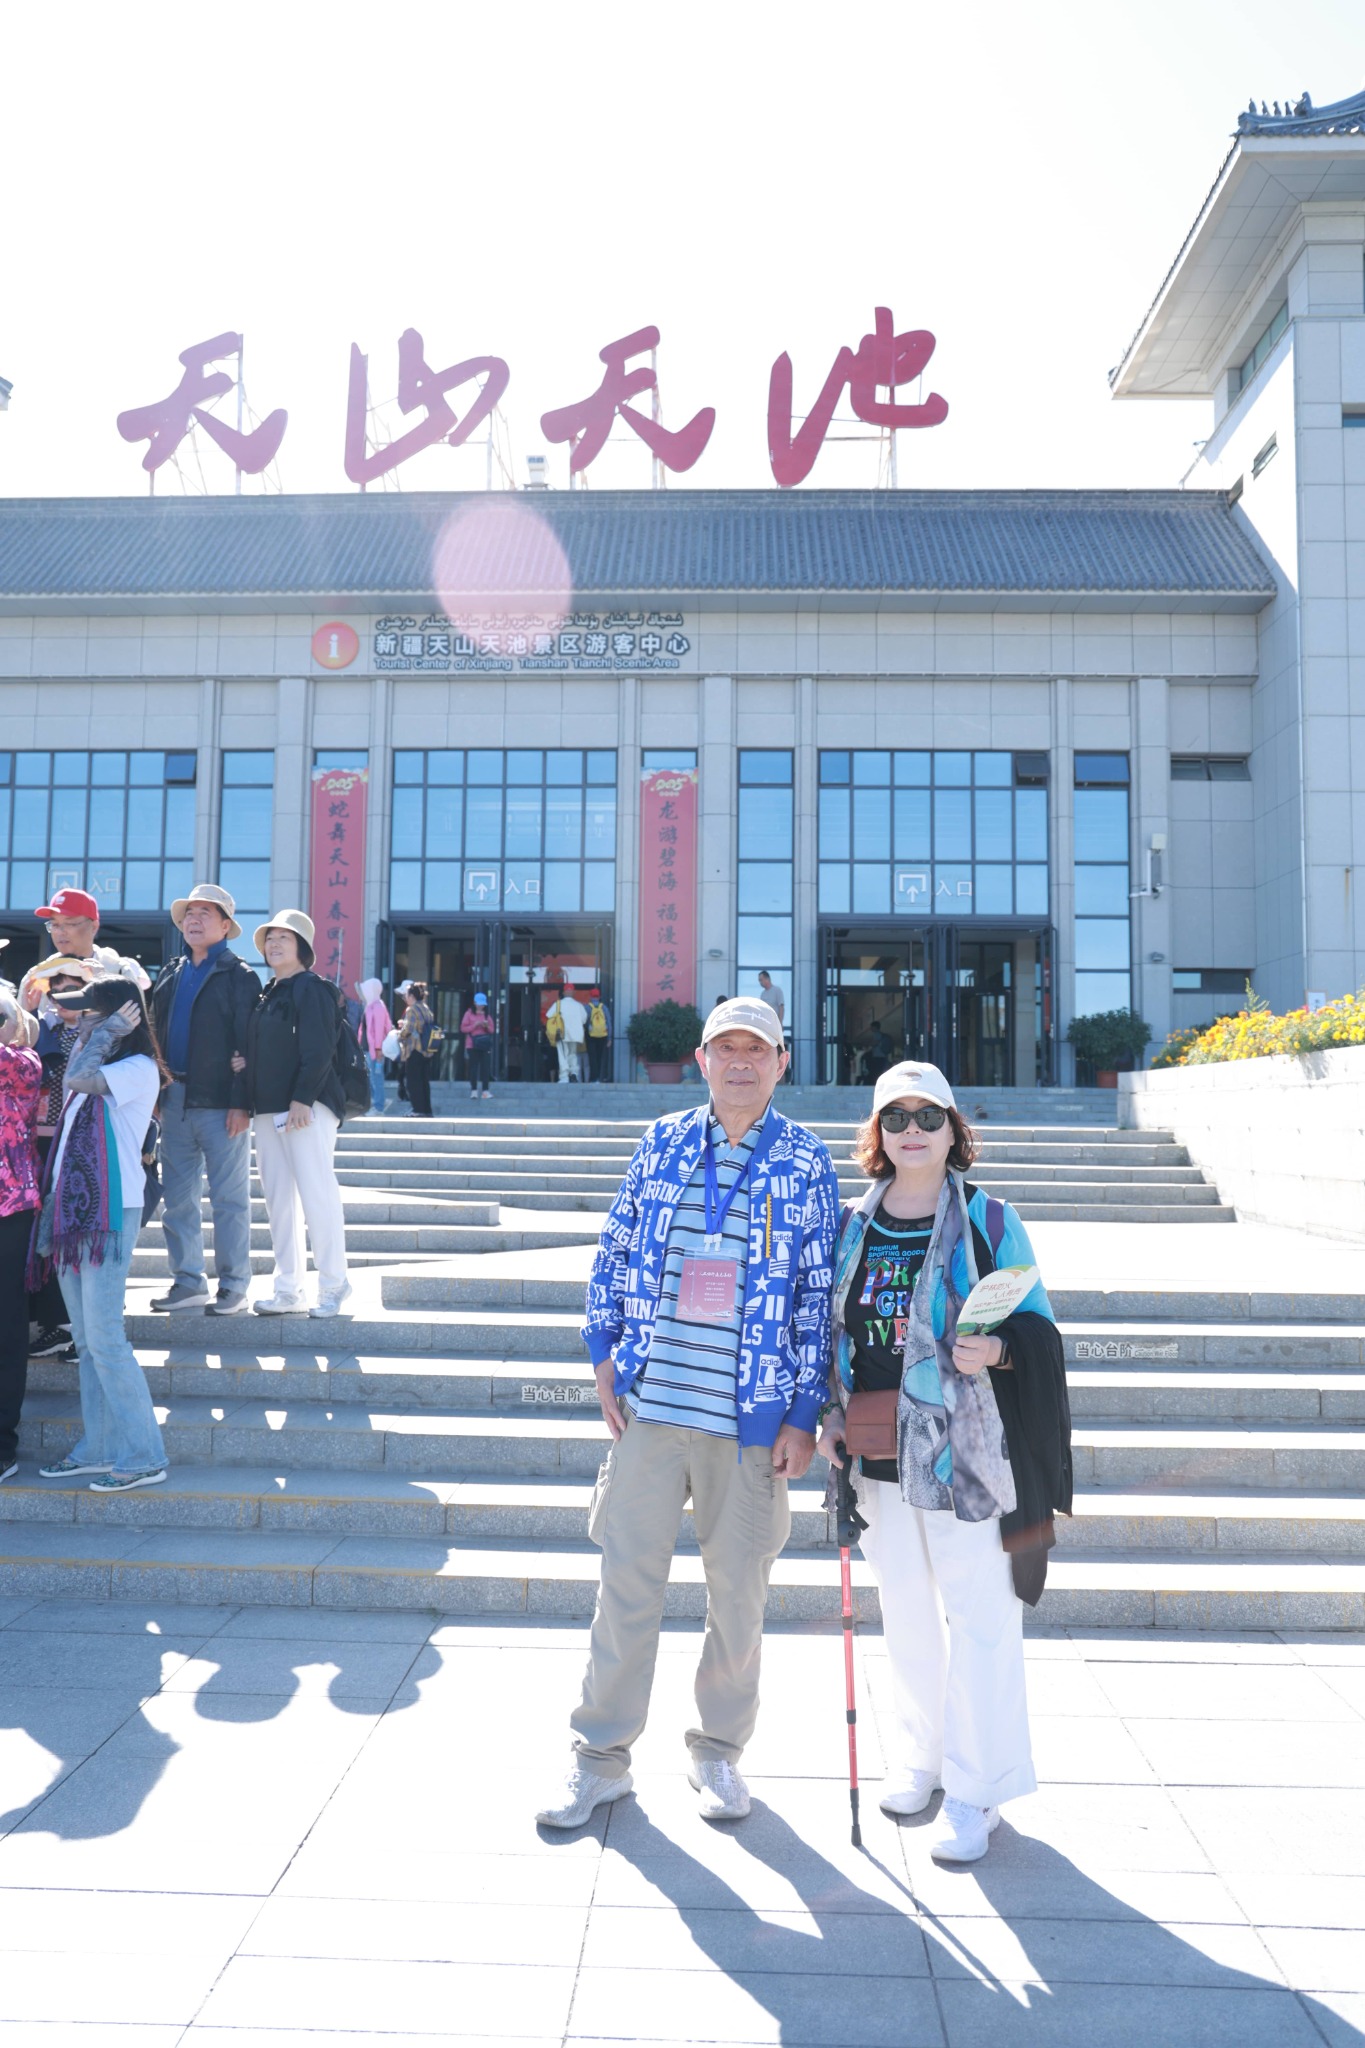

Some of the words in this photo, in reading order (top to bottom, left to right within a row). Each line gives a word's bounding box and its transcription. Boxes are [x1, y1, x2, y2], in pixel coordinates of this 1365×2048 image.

[375, 633, 690, 656] 新疆天山天池景区游客中心
[375, 658, 410, 670] Tourist
[413, 658, 450, 670] Center
[454, 658, 466, 670] of
[469, 658, 512, 671] Xinjiang
[518, 658, 568, 670] Tianshan
[572, 657, 612, 669] Tianchi
[614, 657, 651, 669] Scenic
[652, 657, 680, 669] Area
[88, 877, 120, 893] 入口
[505, 878, 541, 895] 入口
[935, 880, 973, 897] 入口
[867, 1250, 900, 1258] SPORTING
[902, 1249, 926, 1257] GOODS
[868, 1244, 899, 1252] PREMIUM
[1076, 1342, 1133, 1359] 当心台阶
[523, 1385, 582, 1403] 当心台阶
